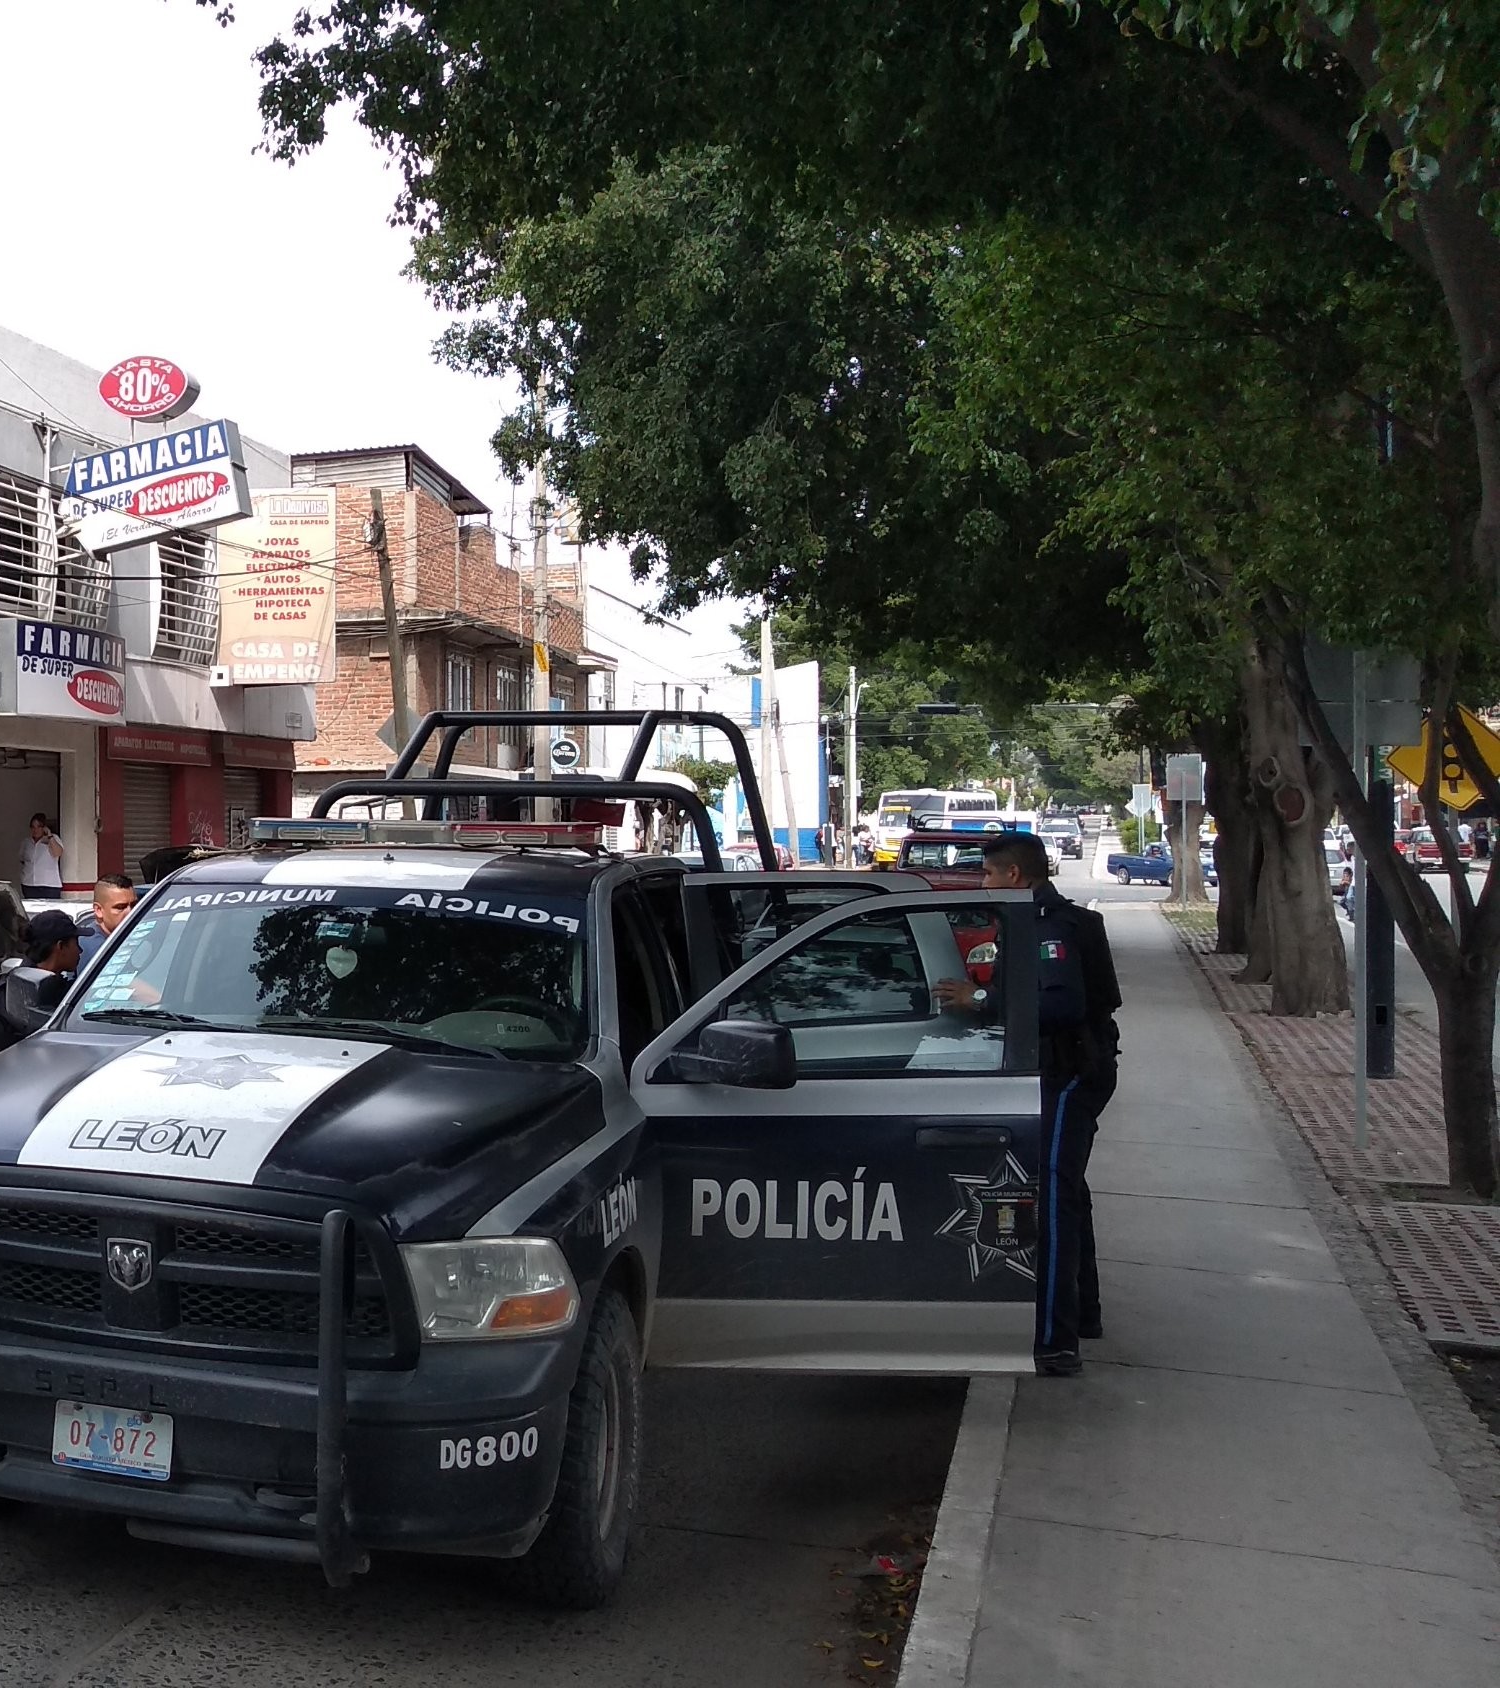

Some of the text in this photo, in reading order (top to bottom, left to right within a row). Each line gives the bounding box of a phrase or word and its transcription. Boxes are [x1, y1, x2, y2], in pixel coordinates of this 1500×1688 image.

[111, 359, 174, 377] HASTA
[119, 367, 170, 404] 80%
[107, 392, 176, 412] AHORRO
[74, 424, 226, 491] FARMACIA
[73, 500, 87, 518] DE
[92, 489, 133, 515] SUPER
[138, 472, 215, 515] DESCUENTOS
[252, 549, 311, 559] APARATOS
[265, 537, 299, 546] JOYAS
[238, 586, 325, 596] HERRAMIENTAS
[263, 575, 301, 584] AUTOS
[253, 611, 307, 620] DE CASAS
[255, 599, 312, 608] HIPOTECA
[24, 624, 123, 668] FARMACIA
[230, 641, 319, 659] CASA DE
[21, 655, 38, 673] DE
[40, 658, 74, 680] SUPER
[76, 676, 120, 708] DESCUENTOS
[69, 1119, 227, 1160] LEÓN
[600, 1172, 638, 1249] LEÓN
[690, 1166, 903, 1242] POLICÍA
[995, 1237, 1019, 1246] LEÓN
[69, 1420, 158, 1458] 07-872
[440, 1426, 539, 1470] DG800
